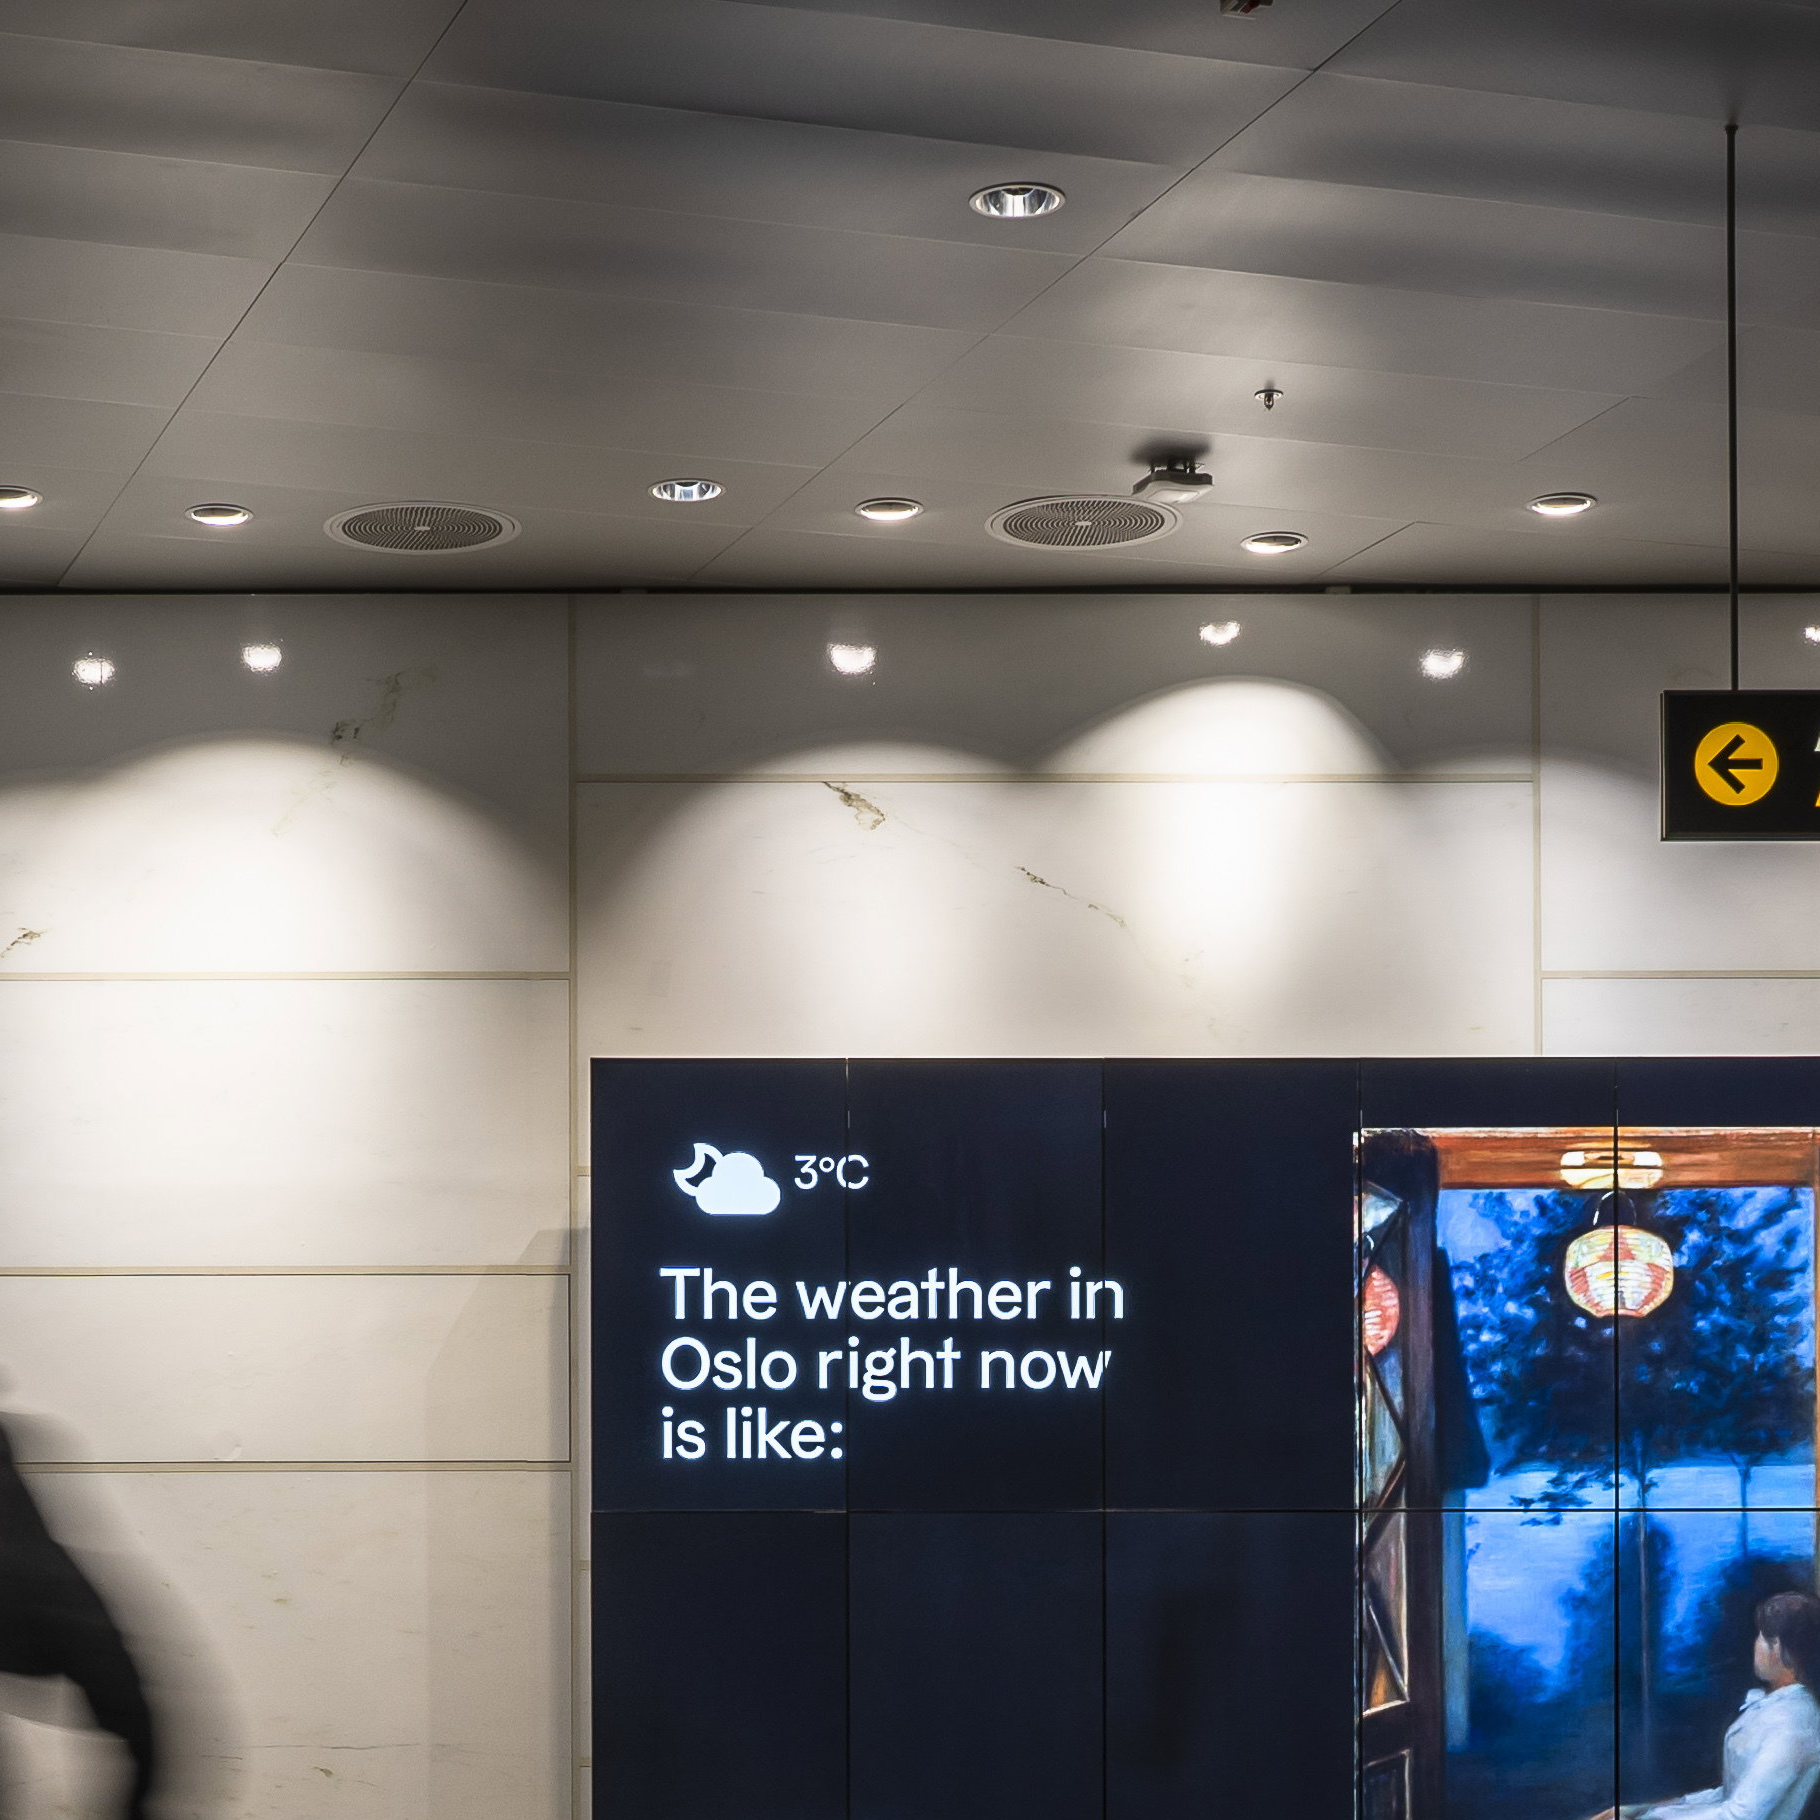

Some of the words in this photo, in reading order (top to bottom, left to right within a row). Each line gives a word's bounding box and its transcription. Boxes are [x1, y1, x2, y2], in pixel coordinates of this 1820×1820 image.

[794, 1153, 869, 1190] 3°C
[659, 1266, 778, 1320] The
[795, 1266, 1051, 1320] weather
[1069, 1265, 1124, 1320] in
[661, 1336, 797, 1391] Oslo
[818, 1335, 962, 1403] right
[980, 1350, 1112, 1390] now
[661, 1405, 706, 1460] is
[726, 1406, 844, 1460] like:
